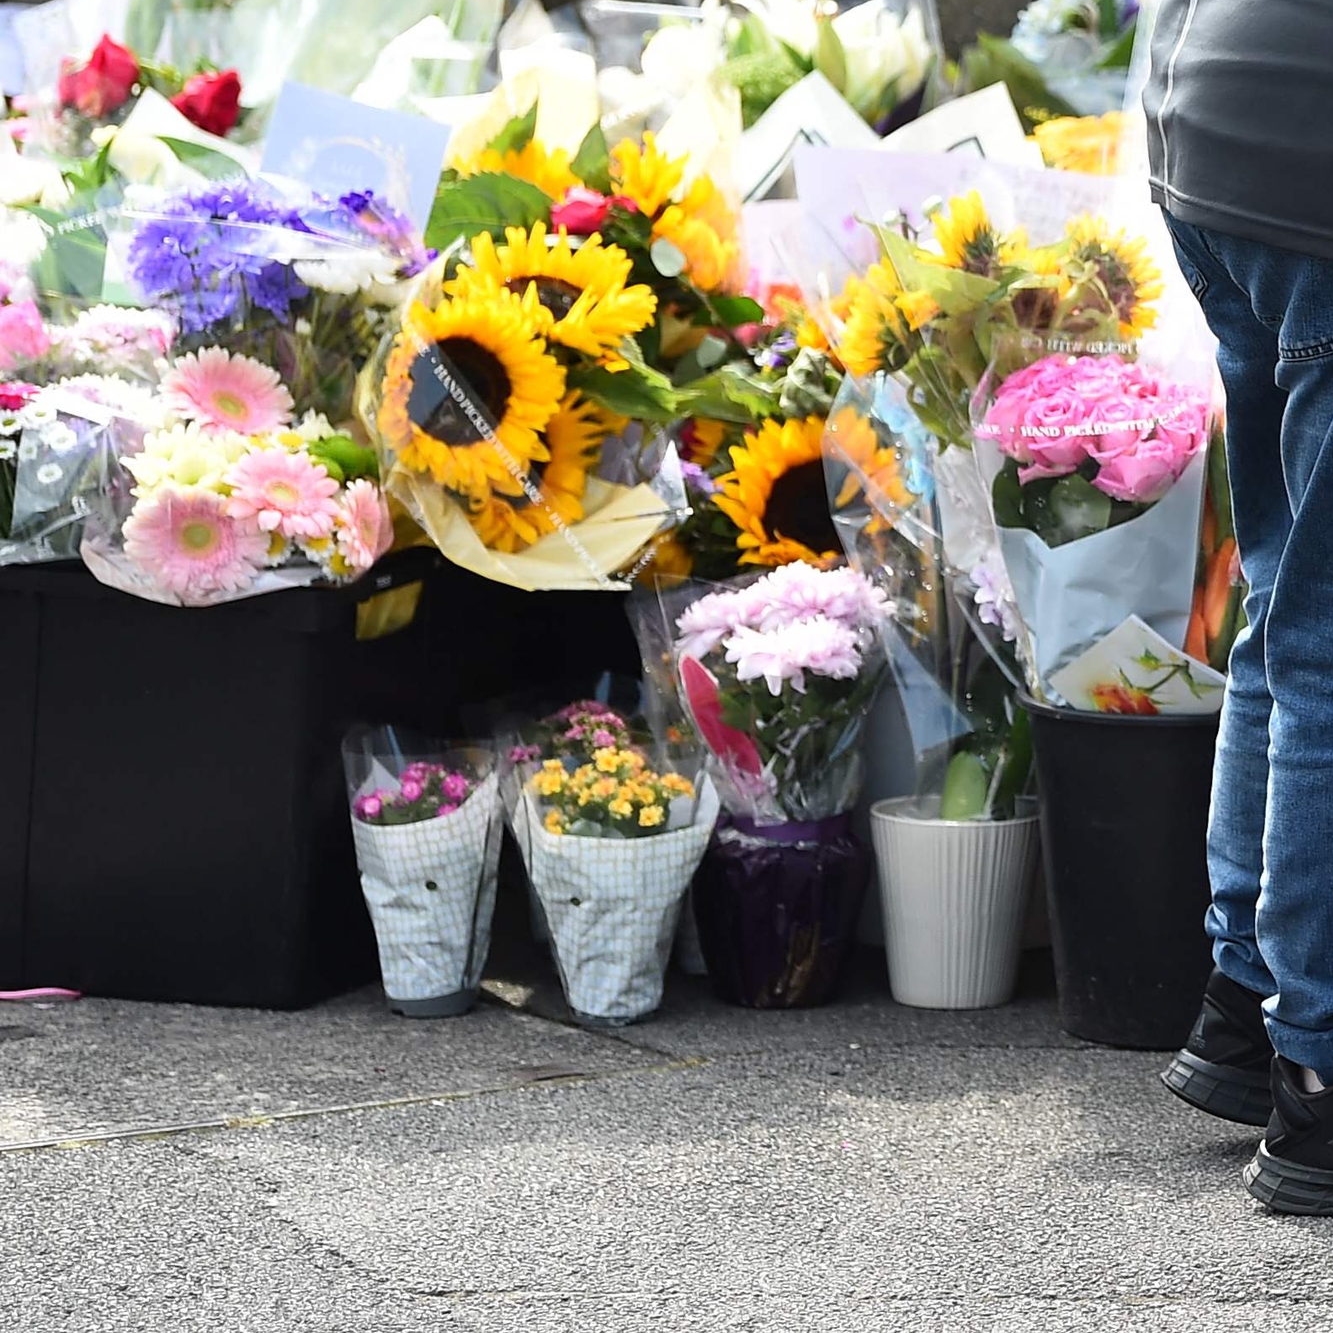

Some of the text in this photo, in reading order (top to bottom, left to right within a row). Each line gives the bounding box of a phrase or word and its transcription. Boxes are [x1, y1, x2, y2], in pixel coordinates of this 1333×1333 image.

[1020, 425, 1061, 438] HAND
[1064, 422, 1119, 437] PICKED
[1119, 417, 1155, 433] WITH
